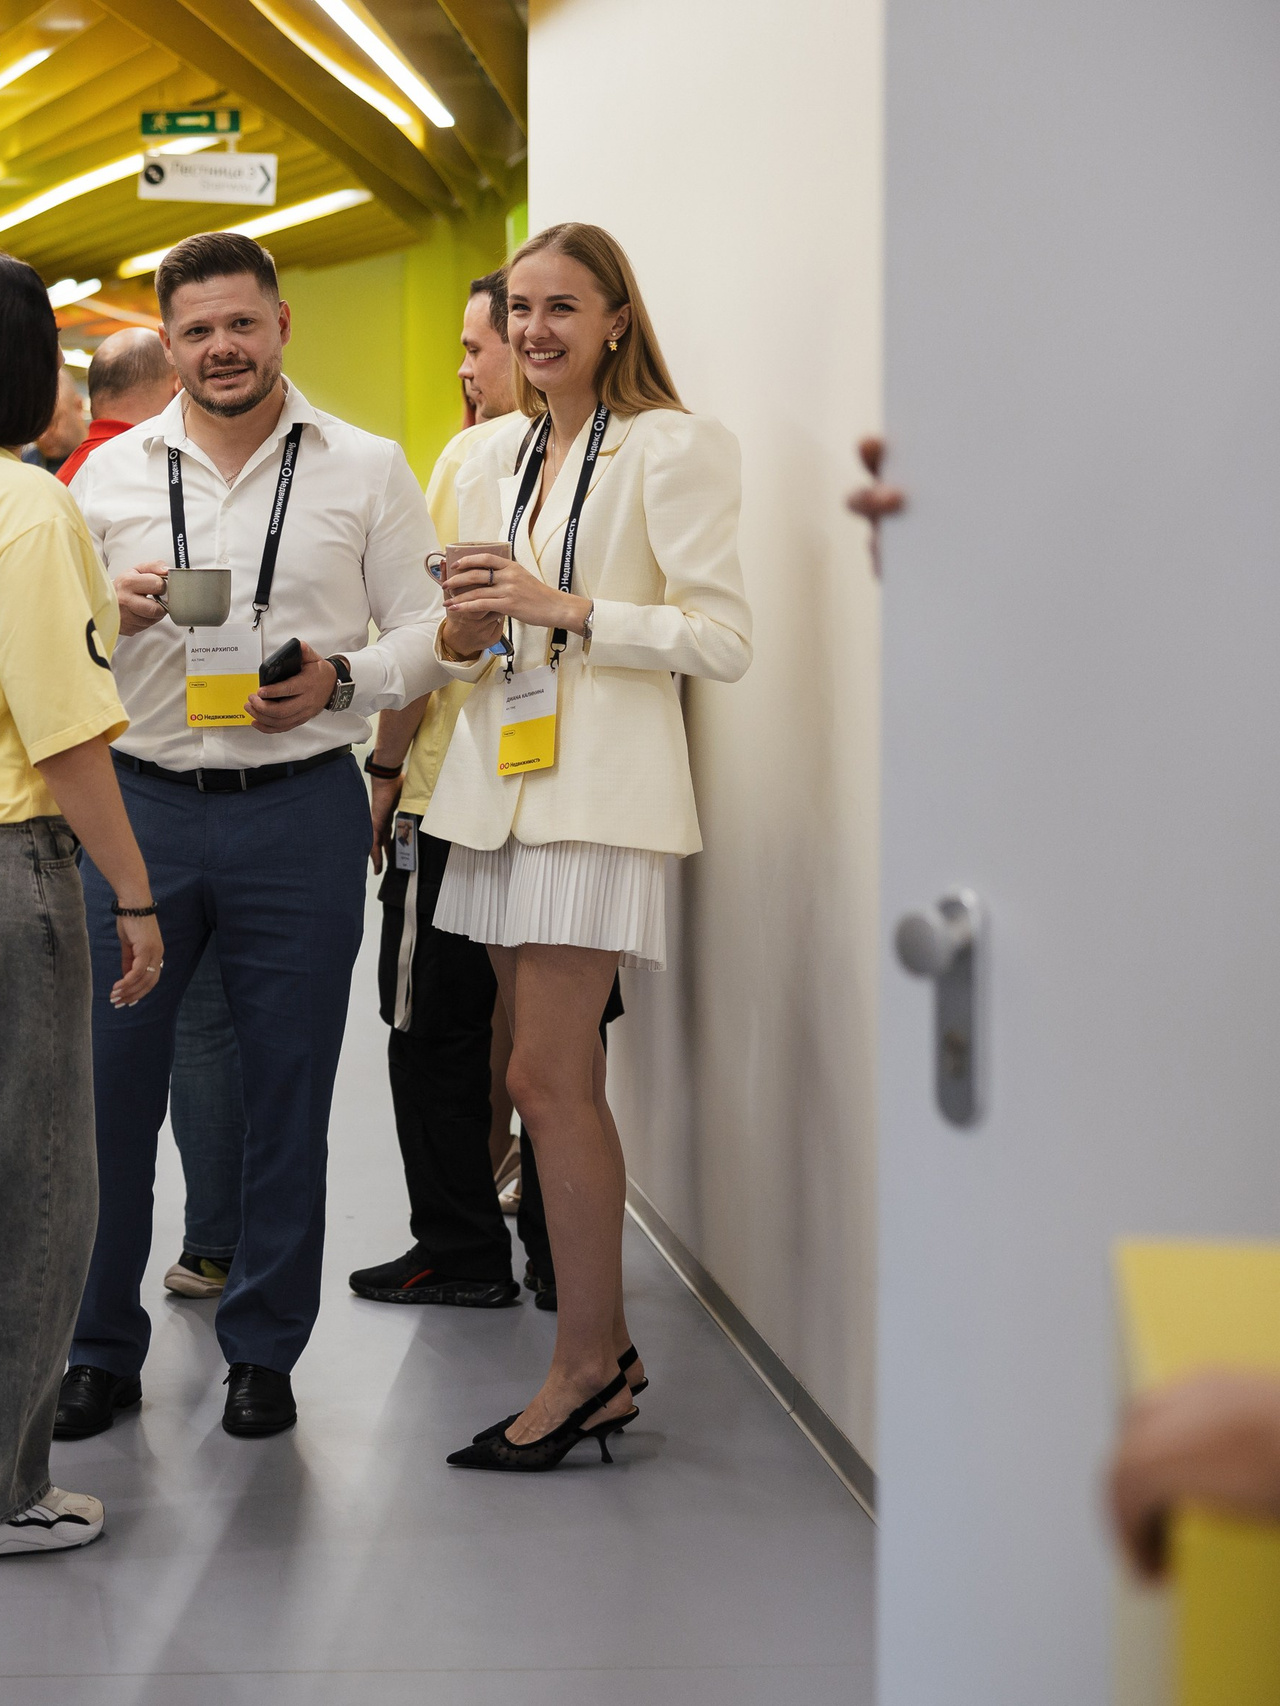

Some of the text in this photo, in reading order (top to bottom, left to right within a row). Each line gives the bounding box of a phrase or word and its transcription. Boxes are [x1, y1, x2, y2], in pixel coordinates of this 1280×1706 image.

[535, 425, 550, 454] Яндекс
[586, 432, 601, 462] Яндекс
[170, 459, 179, 485] Яндекс
[270, 442, 297, 535] Яндекс Недвижимость
[177, 533, 187, 569] жимость
[560, 517, 577, 585] Недвижимость
[506, 689, 544, 703] ДИАНА КАЛИНИНА
[510, 758, 540, 767] Недвижимость
